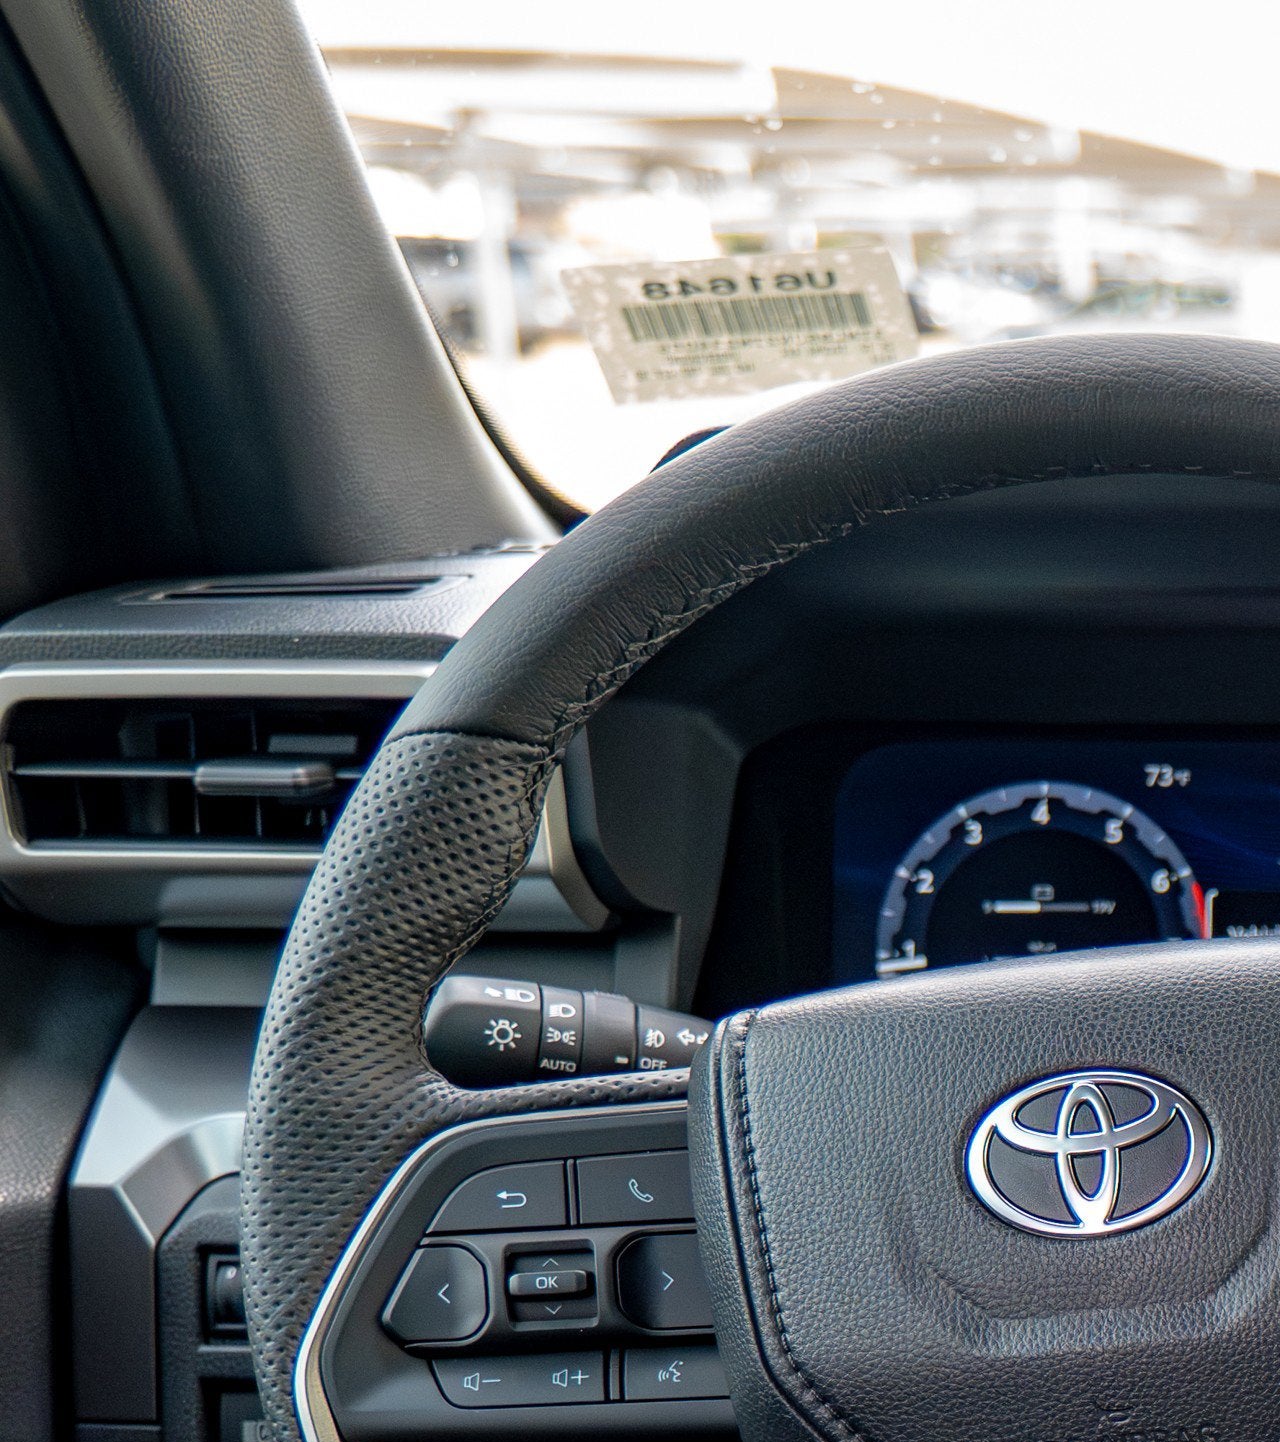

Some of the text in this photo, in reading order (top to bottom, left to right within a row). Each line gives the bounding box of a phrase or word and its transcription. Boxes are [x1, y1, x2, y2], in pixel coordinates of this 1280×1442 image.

[1031, 799, 1050, 825] 4
[963, 818, 983, 846] 3
[1103, 818, 1124, 844] 5
[915, 868, 935, 894] 2
[1151, 868, 1171, 894] 6
[540, 1057, 577, 1073] AUTO
[639, 1056, 668, 1070] OFF
[535, 1275, 559, 1290] OK
